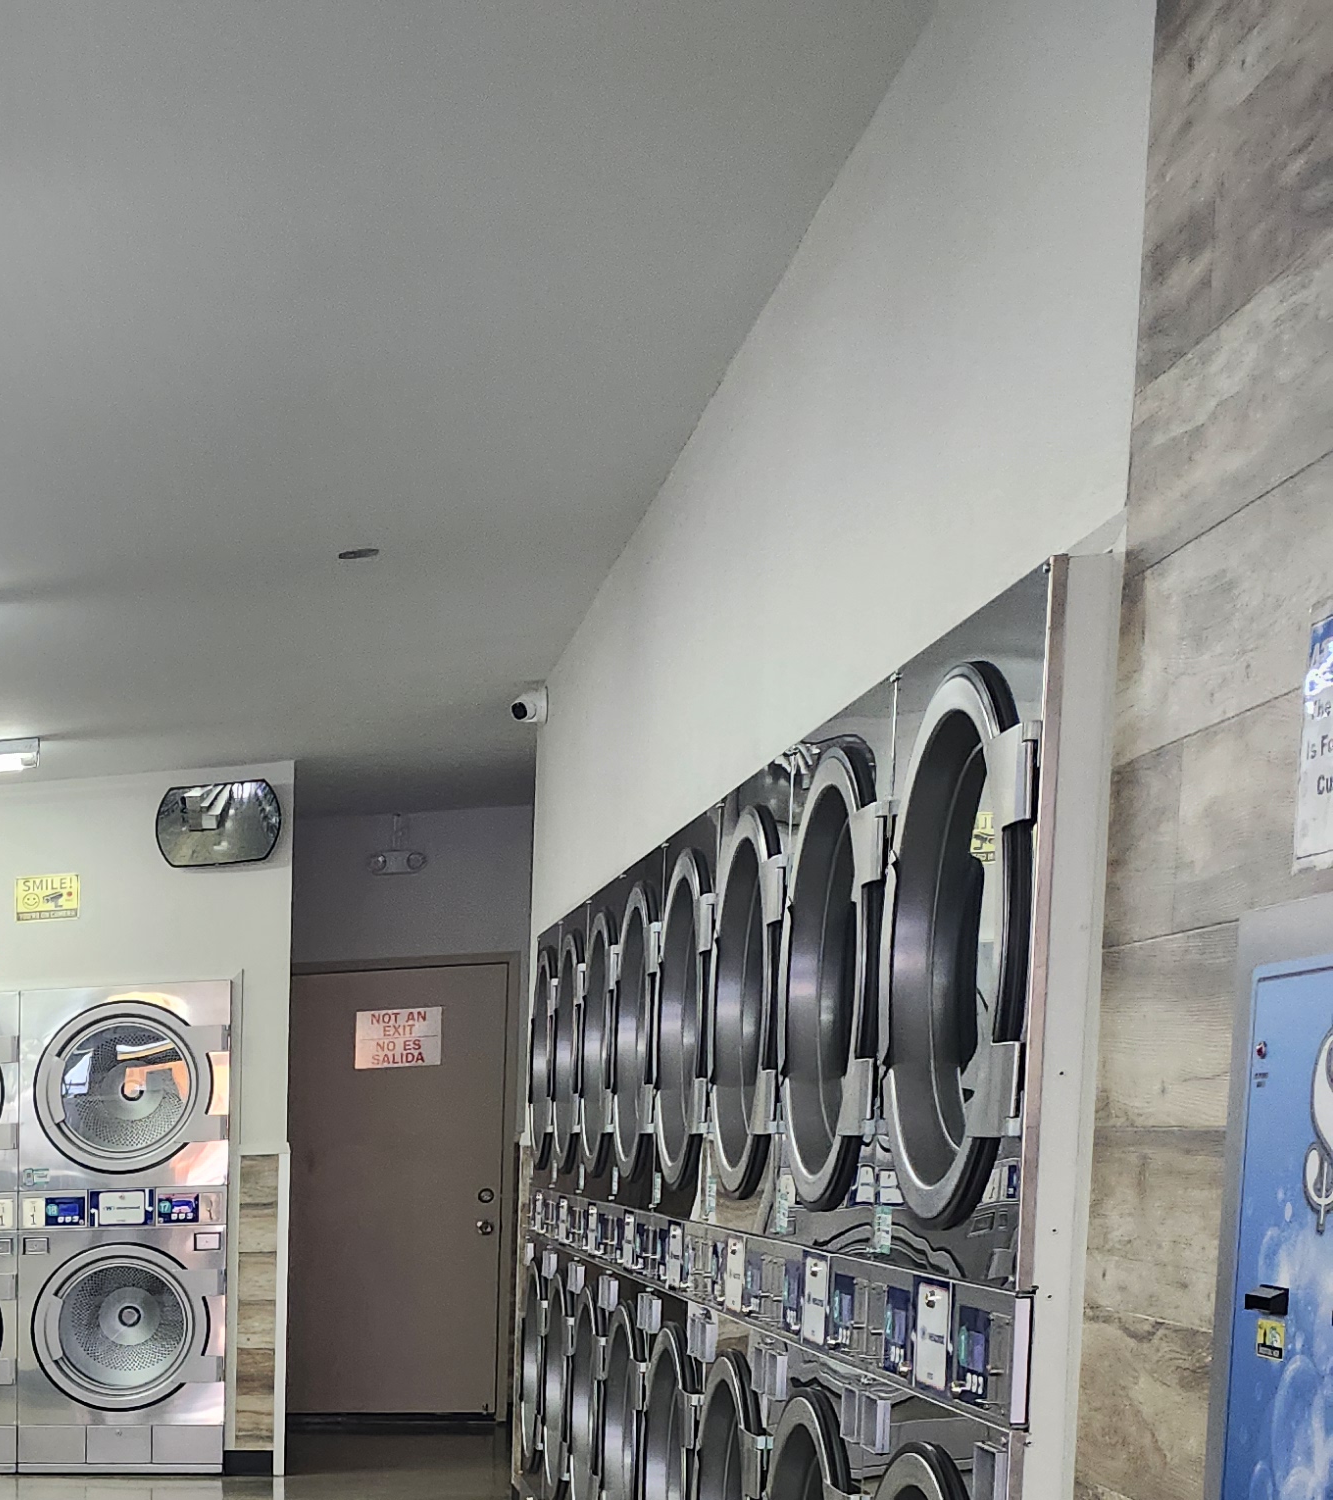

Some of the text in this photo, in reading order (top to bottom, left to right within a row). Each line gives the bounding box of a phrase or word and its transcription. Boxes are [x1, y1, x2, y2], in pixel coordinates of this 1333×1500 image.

[23, 877, 72, 892] SMILE!
[371, 1011, 426, 1025] NOT AN
[383, 1024, 415, 1036] EXIT
[376, 1039, 421, 1052] NO ES
[372, 1052, 425, 1065] SALIDA
